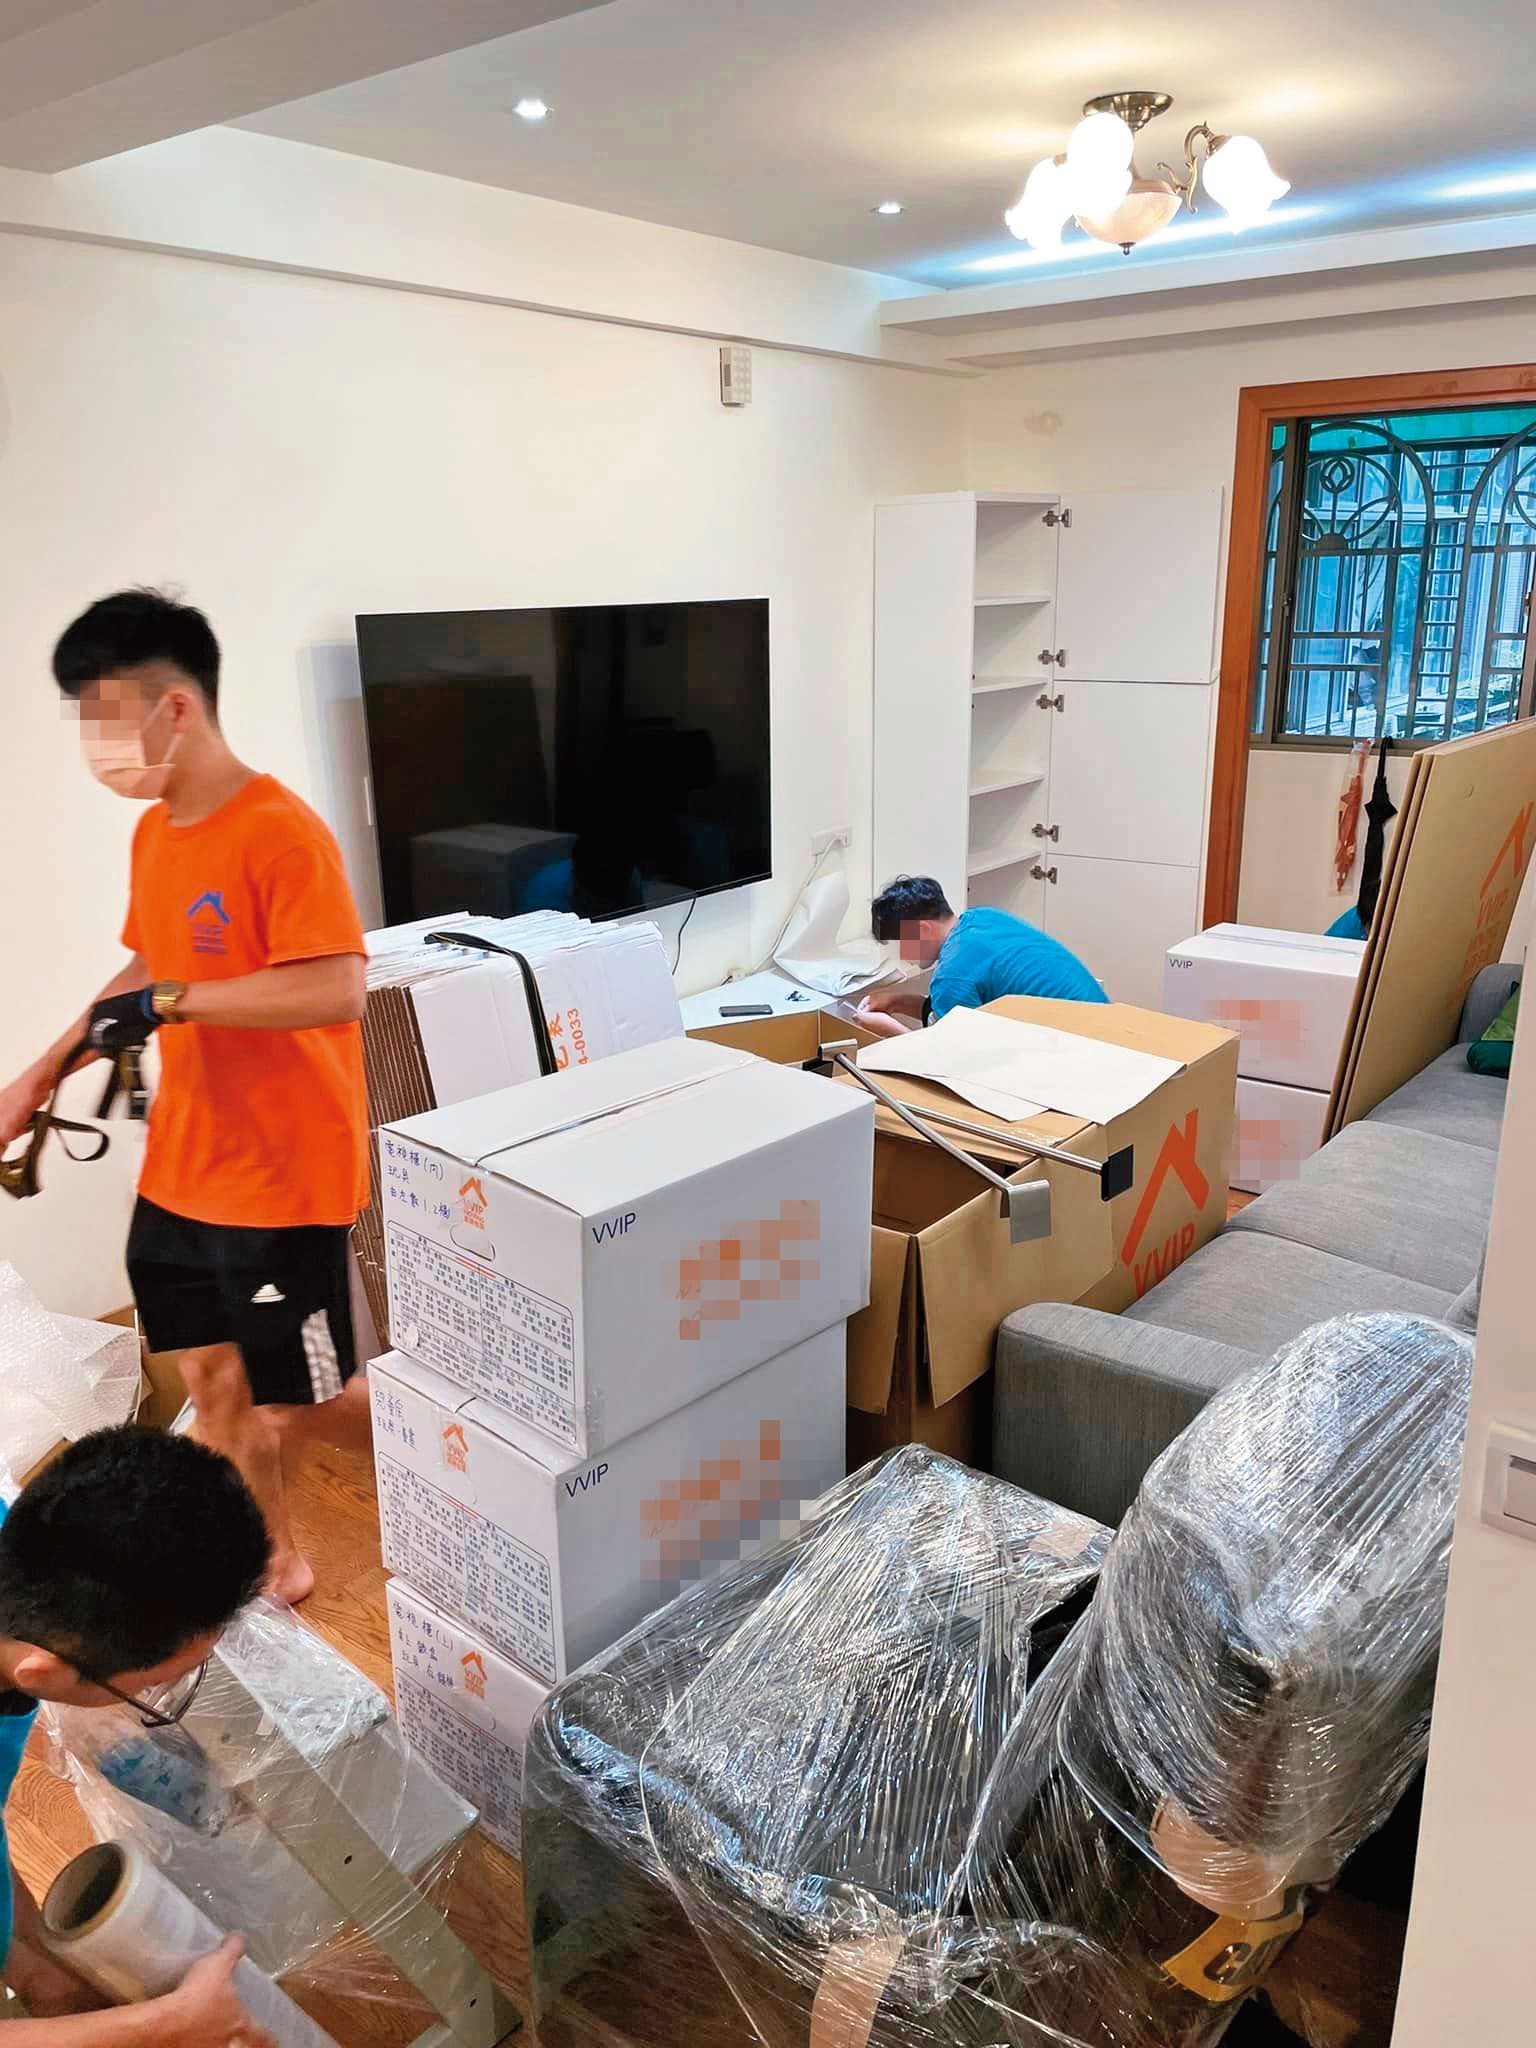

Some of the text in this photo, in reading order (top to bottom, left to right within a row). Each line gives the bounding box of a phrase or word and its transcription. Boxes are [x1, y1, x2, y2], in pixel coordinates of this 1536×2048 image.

[1169, 959, 1193, 968] VVIP
[567, 1008, 589, 1065] 4-0033
[592, 1212, 636, 1244] VVIP
[1133, 1222, 1195, 1300] VVIP
[565, 1463, 608, 1497] VVIP
